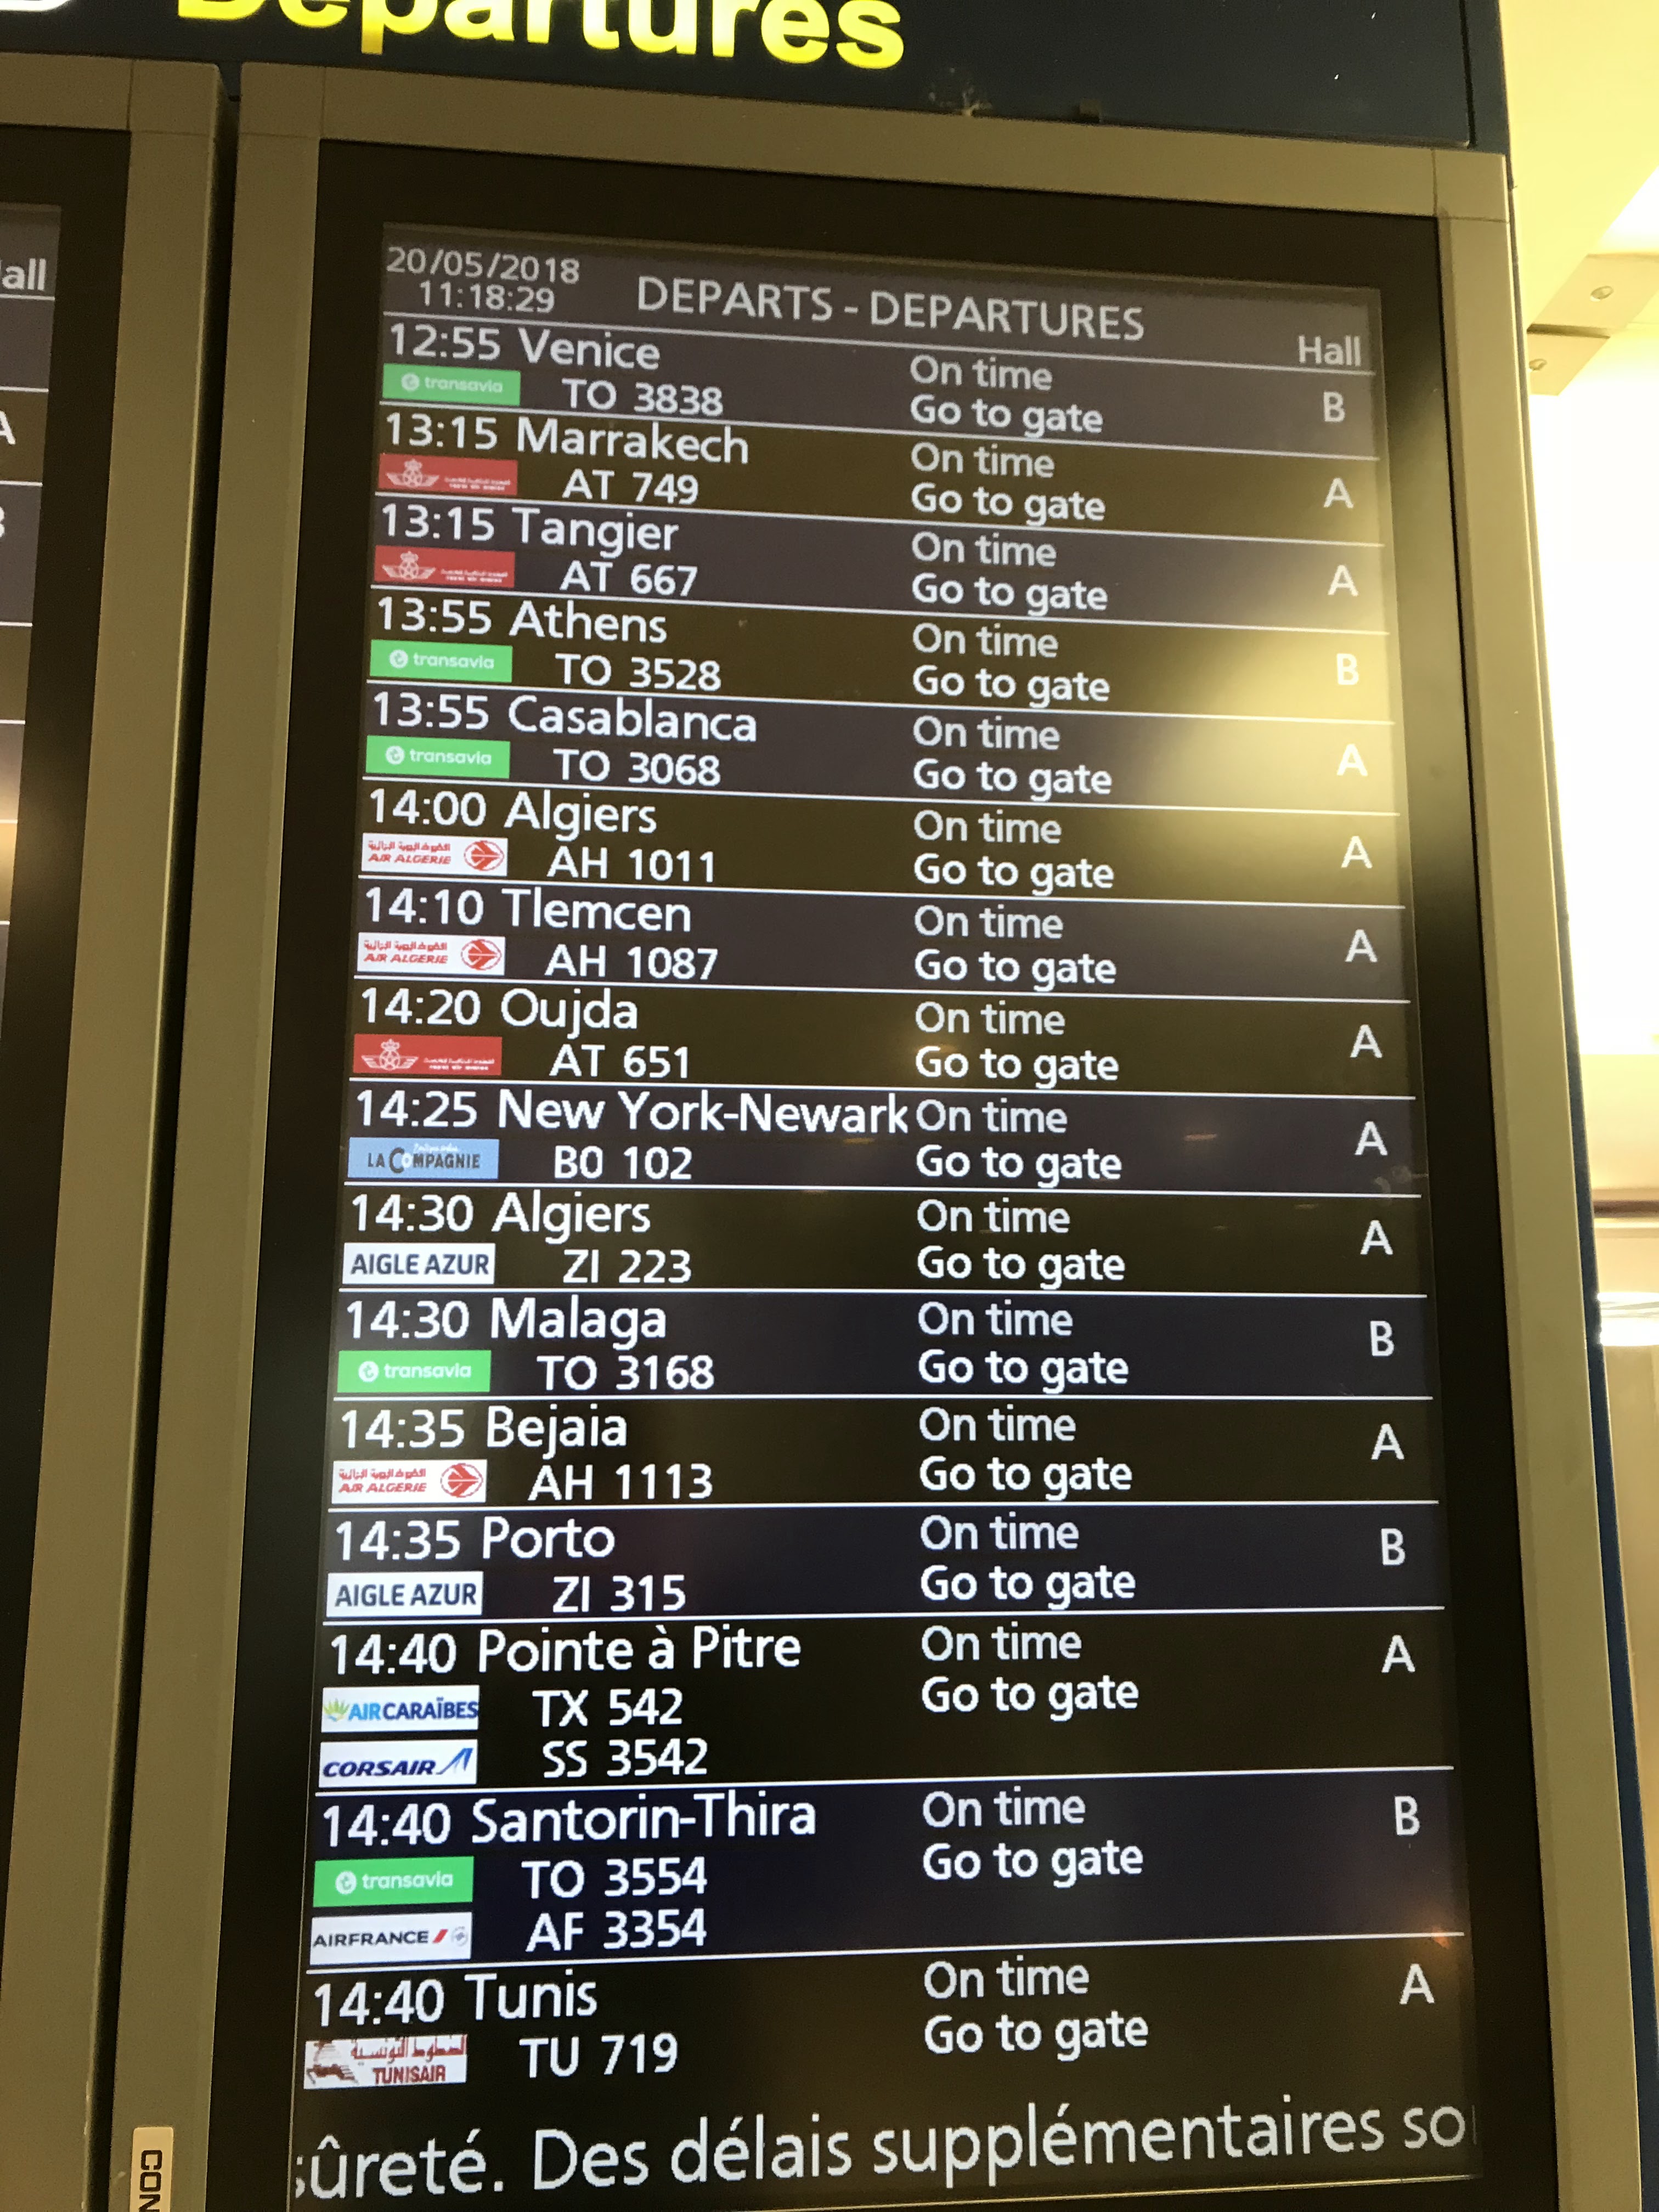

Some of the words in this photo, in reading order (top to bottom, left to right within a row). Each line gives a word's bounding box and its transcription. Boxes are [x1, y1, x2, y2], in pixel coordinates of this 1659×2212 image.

[0, 258, 47, 291] all
[387, 247, 579, 284] 20/05/2018
[421, 280, 554, 313] 11:18:29
[639, 276, 832, 321] DEPARTS
[871, 291, 1143, 340] DEPARTURES
[391, 323, 500, 360] 12:55
[518, 328, 660, 370] Venice
[1299, 335, 1361, 366] Hall
[425, 375, 503, 393] transavia
[911, 355, 962, 386] On
[972, 357, 1052, 391] time
[562, 378, 616, 410] TO
[634, 382, 723, 416] 3838
[1324, 392, 1345, 422] B
[911, 394, 961, 425] Go
[972, 399, 1011, 427] to
[1023, 404, 1103, 437] gate
[387, 413, 497, 449] 13:15
[518, 417, 748, 464] Marrakech
[562, 469, 614, 500] AT
[633, 472, 698, 505] 749
[1324, 478, 1353, 508] A
[382, 504, 494, 540] 13:15
[512, 507, 679, 558] Tangier
[560, 560, 613, 592] AT
[631, 564, 697, 596] 667
[1328, 565, 1358, 596] A
[379, 596, 491, 634] 13:55
[509, 600, 667, 643] Athens
[414, 652, 494, 669] transavia
[555, 653, 611, 686] TO
[630, 657, 721, 691] 3528
[1337, 653, 1358, 685] B
[374, 691, 488, 729] 13:55
[509, 695, 756, 741] Casablanca
[913, 716, 967, 747] On
[977, 715, 1060, 750] time
[410, 748, 492, 765] transavia
[553, 749, 610, 781] TO
[629, 752, 720, 786] 3068
[1338, 744, 1367, 776] A
[914, 758, 965, 789] Go
[977, 761, 1017, 791] to
[1029, 764, 1113, 802] gate
[370, 788, 486, 826] 14:00
[504, 789, 656, 841] Algiers
[367, 853, 392, 865] AIR
[547, 846, 607, 878] AH
[629, 849, 713, 882] 1011
[1341, 836, 1372, 868] A
[366, 887, 483, 925] 14:10
[501, 887, 690, 932] Tlemcen
[363, 952, 388, 963] AIR
[545, 944, 606, 977] AH
[628, 946, 718, 979] 1087
[1345, 929, 1377, 962] A
[362, 988, 481, 1025] 14:20
[501, 988, 637, 1039] Oujda
[1350, 1025, 1382, 1058] A
[549, 1044, 605, 1076] AT
[624, 1046, 687, 1078] 651
[358, 1090, 477, 1127] 14:25
[499, 1089, 605, 1128] New
[618, 1090, 907, 1133] York-Newark
[916, 1099, 970, 1131] On
[982, 1098, 1067, 1133] time
[1355, 1121, 1387, 1155] A
[368, 1153, 385, 1168] LA
[624, 1147, 692, 1179] 102
[917, 1144, 970, 1176] Go
[981, 1147, 1024, 1177] to
[1036, 1149, 1121, 1188] gate
[353, 1194, 473, 1231] 14:30
[492, 1189, 650, 1244] Algiers
[1361, 1220, 1393, 1255] A
[351, 1254, 420, 1275] AIGLE
[424, 1254, 489, 1274] AZUR
[563, 1250, 599, 1283] ZI
[619, 1250, 691, 1283] 223
[347, 1301, 469, 1339] 14:30
[492, 1294, 665, 1350] Malaga
[1370, 1321, 1394, 1356] B
[384, 1363, 471, 1379] transavia
[537, 1356, 597, 1390] TO
[616, 1355, 714, 1390] 3168
[342, 1409, 464, 1448] 14:35
[487, 1403, 627, 1459] Bejaia
[919, 1407, 976, 1441] On
[988, 1404, 1076, 1441] time
[1372, 1424, 1404, 1459] A
[338, 1482, 364, 1493] AIR
[528, 1465, 592, 1500] AH
[616, 1464, 712, 1499] 1113
[920, 1456, 975, 1490] Go
[987, 1457, 1030, 1490] to
[1044, 1458, 1132, 1501] gate
[336, 1520, 460, 1560] 14:35
[483, 1516, 614, 1559] Porto
[1381, 1528, 1405, 1565] B
[335, 1584, 405, 1607] AIGLE
[410, 1583, 477, 1606] AZUR
[553, 1576, 590, 1612] ZI
[611, 1575, 685, 1611] 315
[331, 1633, 456, 1674] 14:40
[479, 1627, 633, 1672] Pointe
[649, 1625, 674, 1669] à
[694, 1624, 801, 1668] Pitre
[1381, 1635, 1415, 1673] A
[532, 1690, 588, 1726] TX
[610, 1688, 682, 1725] 542
[323, 1760, 436, 1777] CORSAIR
[543, 1740, 587, 1778] SS
[607, 1738, 707, 1776] 3542
[324, 1803, 450, 1847] 14:40
[472, 1790, 815, 1843] Santorin-Thira
[1395, 1796, 1420, 1835] B
[362, 1870, 453, 1889] transavia
[522, 1860, 584, 1899] TO
[605, 1857, 707, 1896] 3554
[526, 1912, 583, 1951] AF
[603, 1908, 707, 1949] 3354
[924, 1961, 984, 1999] On
[996, 1955, 1089, 1996] time
[1400, 1964, 1434, 2004] A
[315, 1979, 444, 2026] 14:40
[465, 1969, 597, 2019] Tunis
[925, 2015, 983, 2053] Go
[996, 2015, 1041, 2051] to
[1056, 2011, 1148, 2061] gate
[519, 2037, 579, 2078] TU
[601, 2033, 677, 2074] 719
[373, 2065, 446, 2084] TUNISAIR
[534, 2129, 648, 2190] Des
[672, 2114, 851, 2182] délais
[874, 2095, 1384, 2188] supplémentaires
[1403, 2104, 1476, 2149] so
